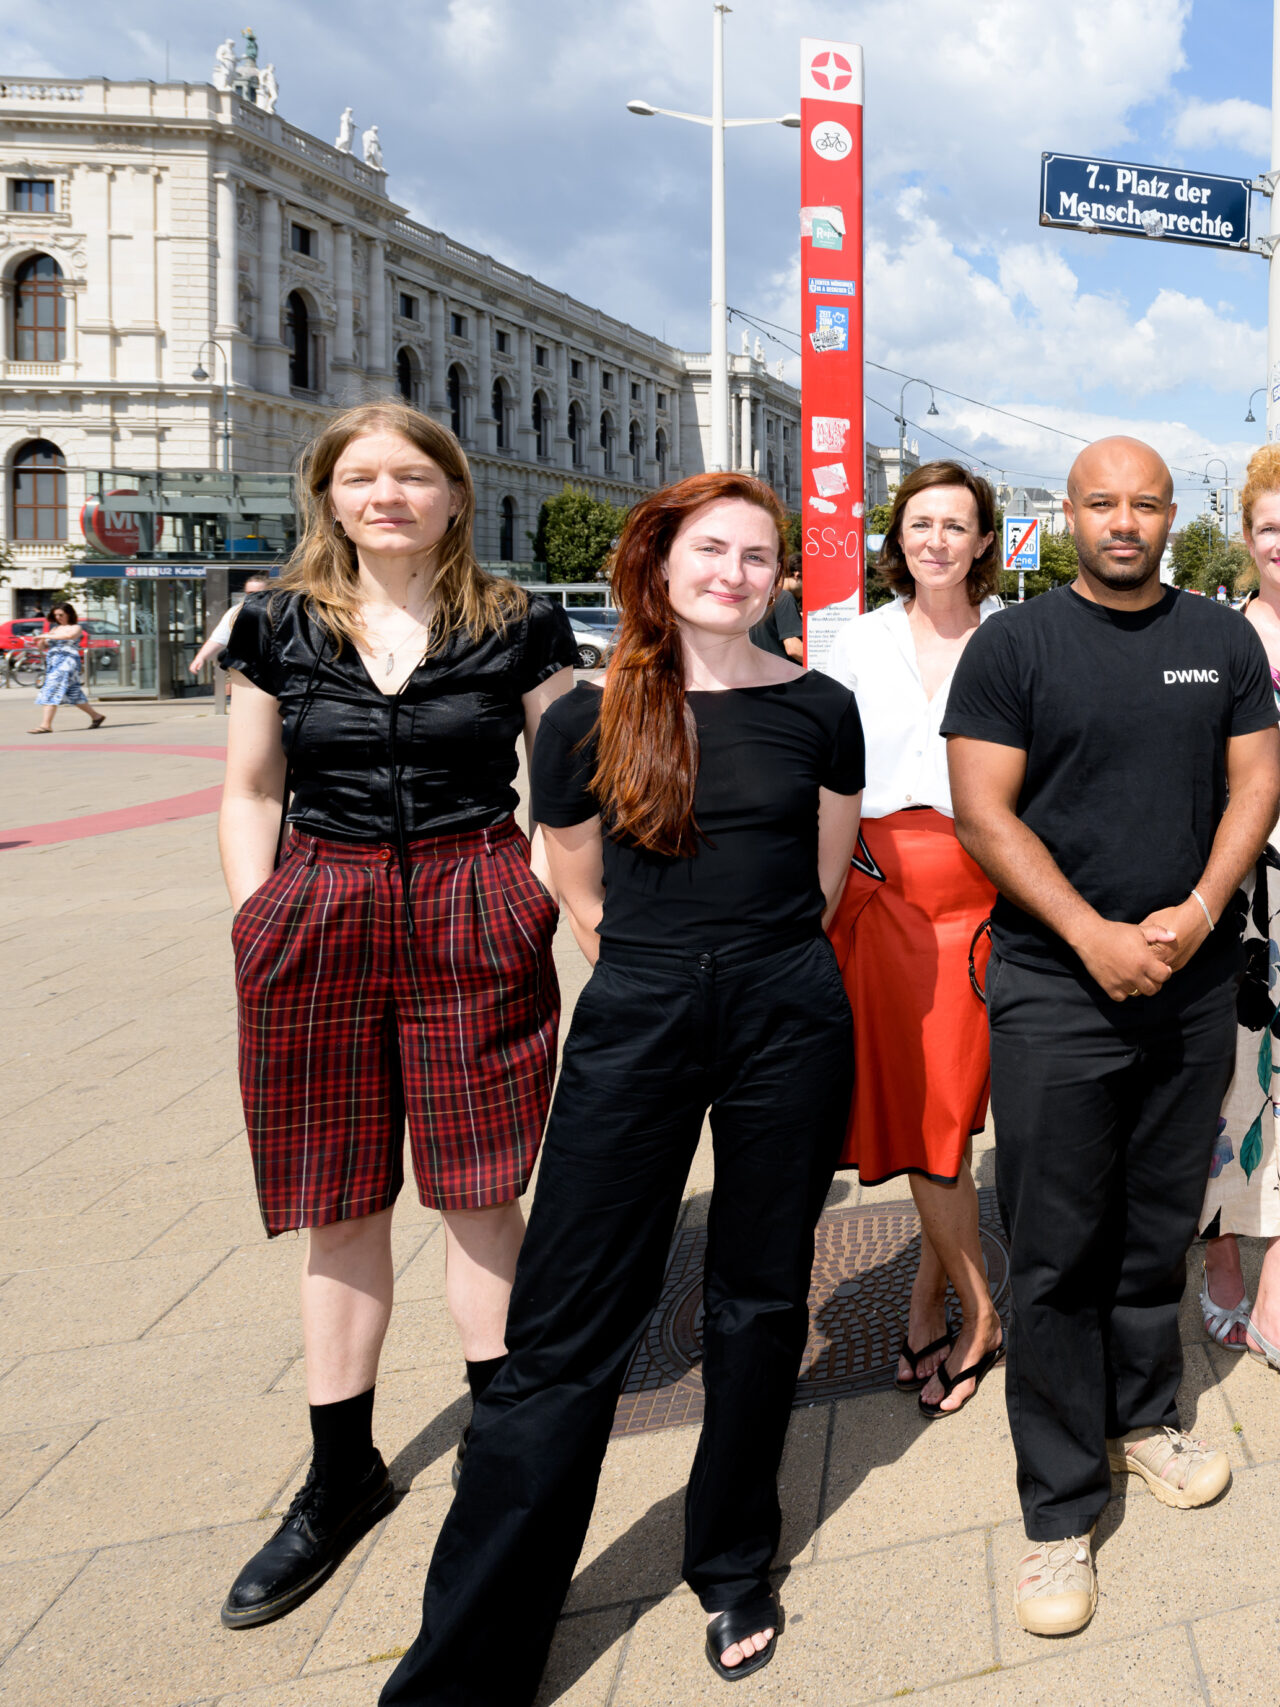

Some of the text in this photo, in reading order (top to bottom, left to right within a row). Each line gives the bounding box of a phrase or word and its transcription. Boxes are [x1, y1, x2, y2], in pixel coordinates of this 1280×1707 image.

[1086, 164, 1211, 204] 7., Platz der
[1059, 191, 1234, 238] Menschnrechte
[1024, 542, 1035, 552] 20
[159, 566, 173, 575] U2
[1163, 669, 1220, 684] DWMC
